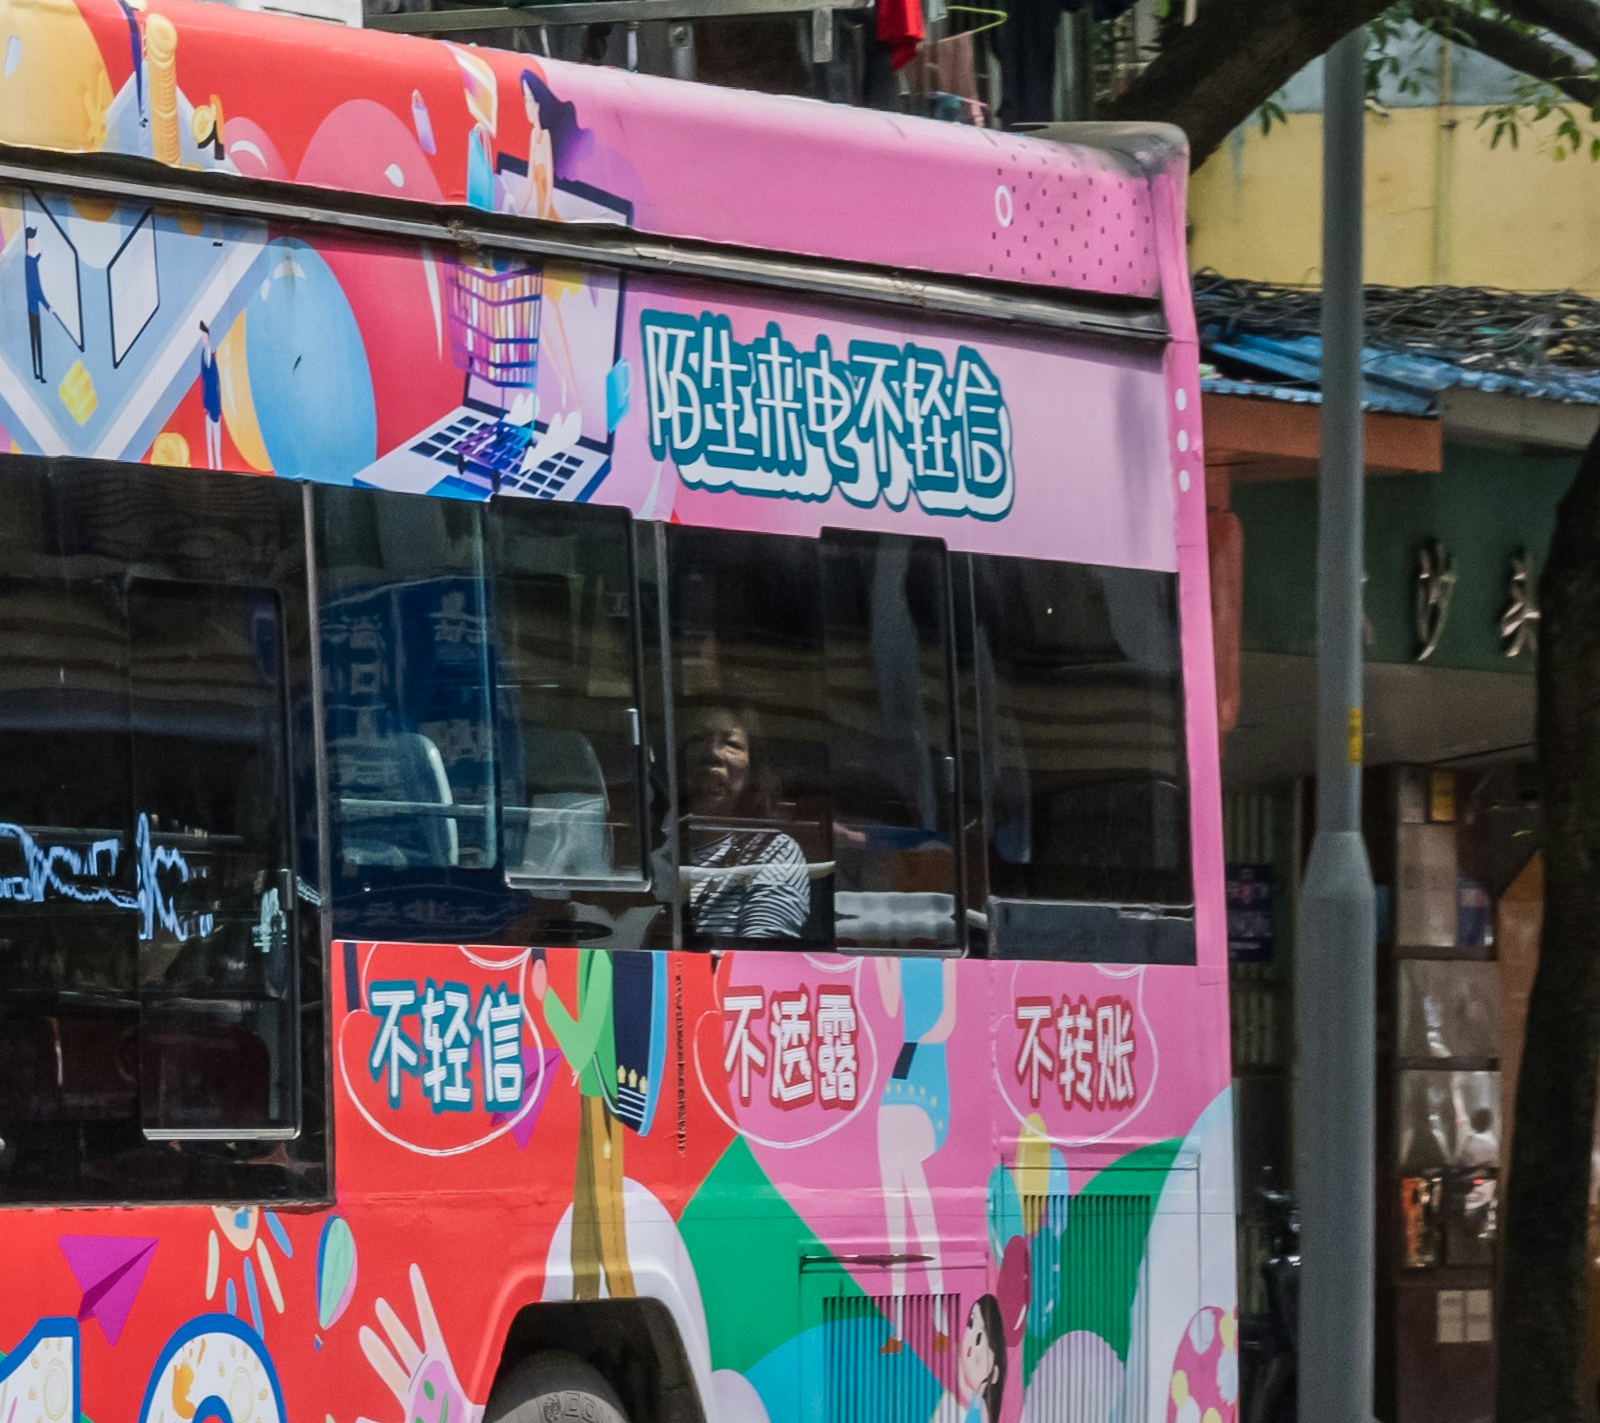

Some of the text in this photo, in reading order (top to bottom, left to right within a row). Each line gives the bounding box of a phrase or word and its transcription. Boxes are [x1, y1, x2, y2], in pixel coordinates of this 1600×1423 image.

[646, 320, 1005, 488] 陌生来电不轻信
[367, 979, 527, 1111] 不轻信
[723, 987, 860, 1109] 不透露
[1016, 996, 1137, 1110] 不转账
